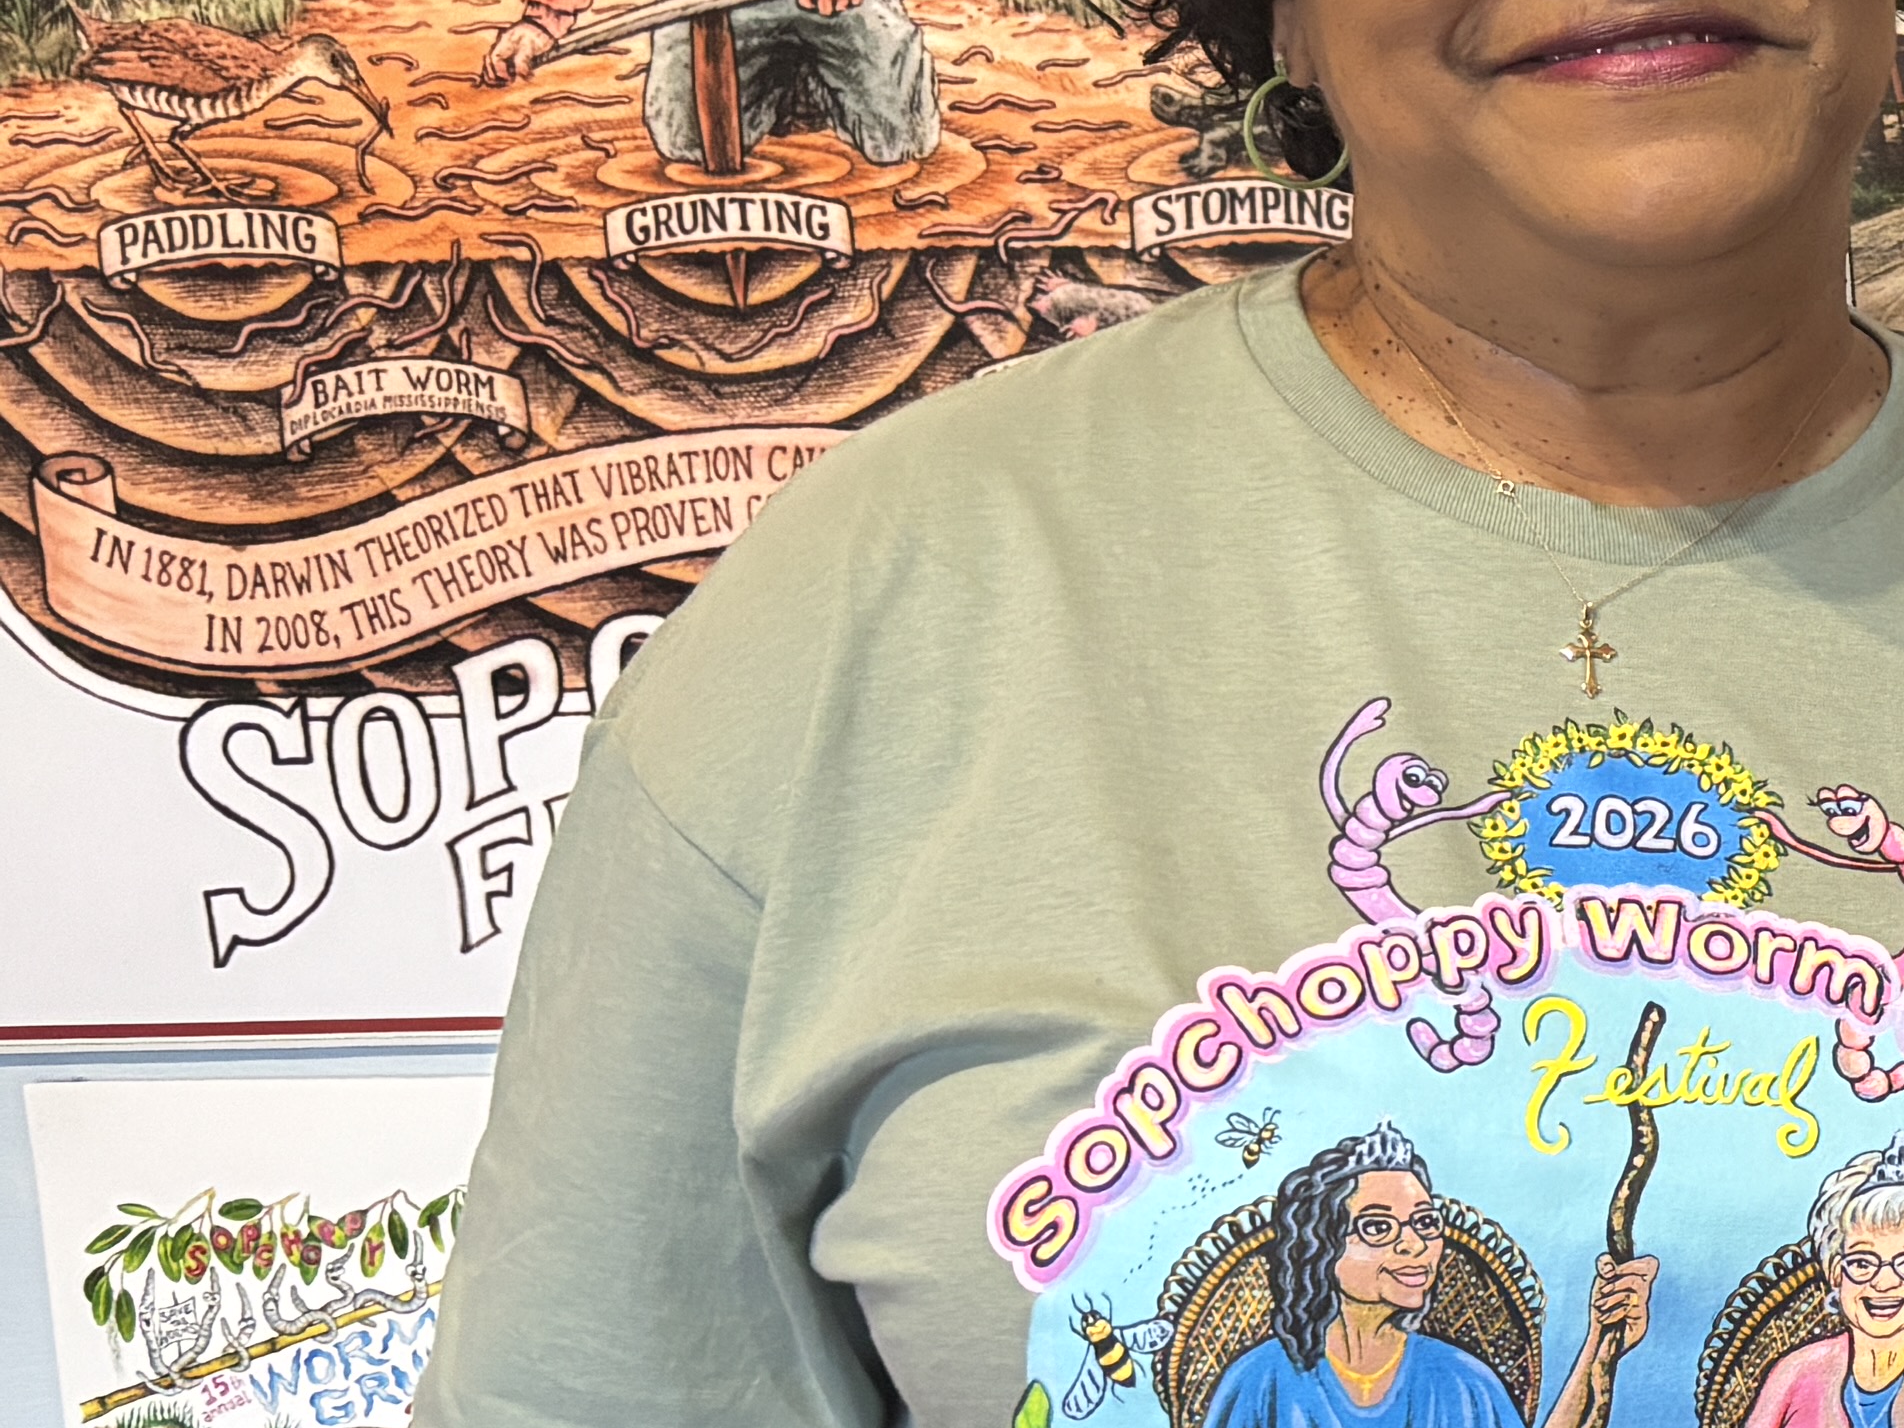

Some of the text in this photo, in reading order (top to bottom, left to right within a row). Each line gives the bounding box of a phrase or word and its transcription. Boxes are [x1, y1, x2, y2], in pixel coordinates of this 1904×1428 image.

[116, 216, 319, 262] PADDLING
[625, 194, 833, 244] GRUNTING
[1152, 186, 1351, 237] STOMPING
[311, 365, 497, 409] BAIT WORM
[90, 525, 136, 577] IN
[141, 546, 215, 606] 1881,
[225, 549, 354, 604] DARWIN
[354, 493, 510, 574] THEORIZED
[510, 470, 584, 519] THAT
[594, 444, 754, 501] VIBRATION
[203, 613, 243, 656] IN
[255, 614, 342, 656] 2008,
[344, 592, 412, 642] THIS
[420, 539, 533, 612] THEORY
[537, 513, 611, 566] WAS
[615, 495, 735, 548] PROVEN
[1548, 794, 1721, 860] 2026
[1001, 892, 1546, 1277] Sopchoppy
[1579, 895, 1885, 1021] Worm
[1522, 996, 1820, 1159] Festival
